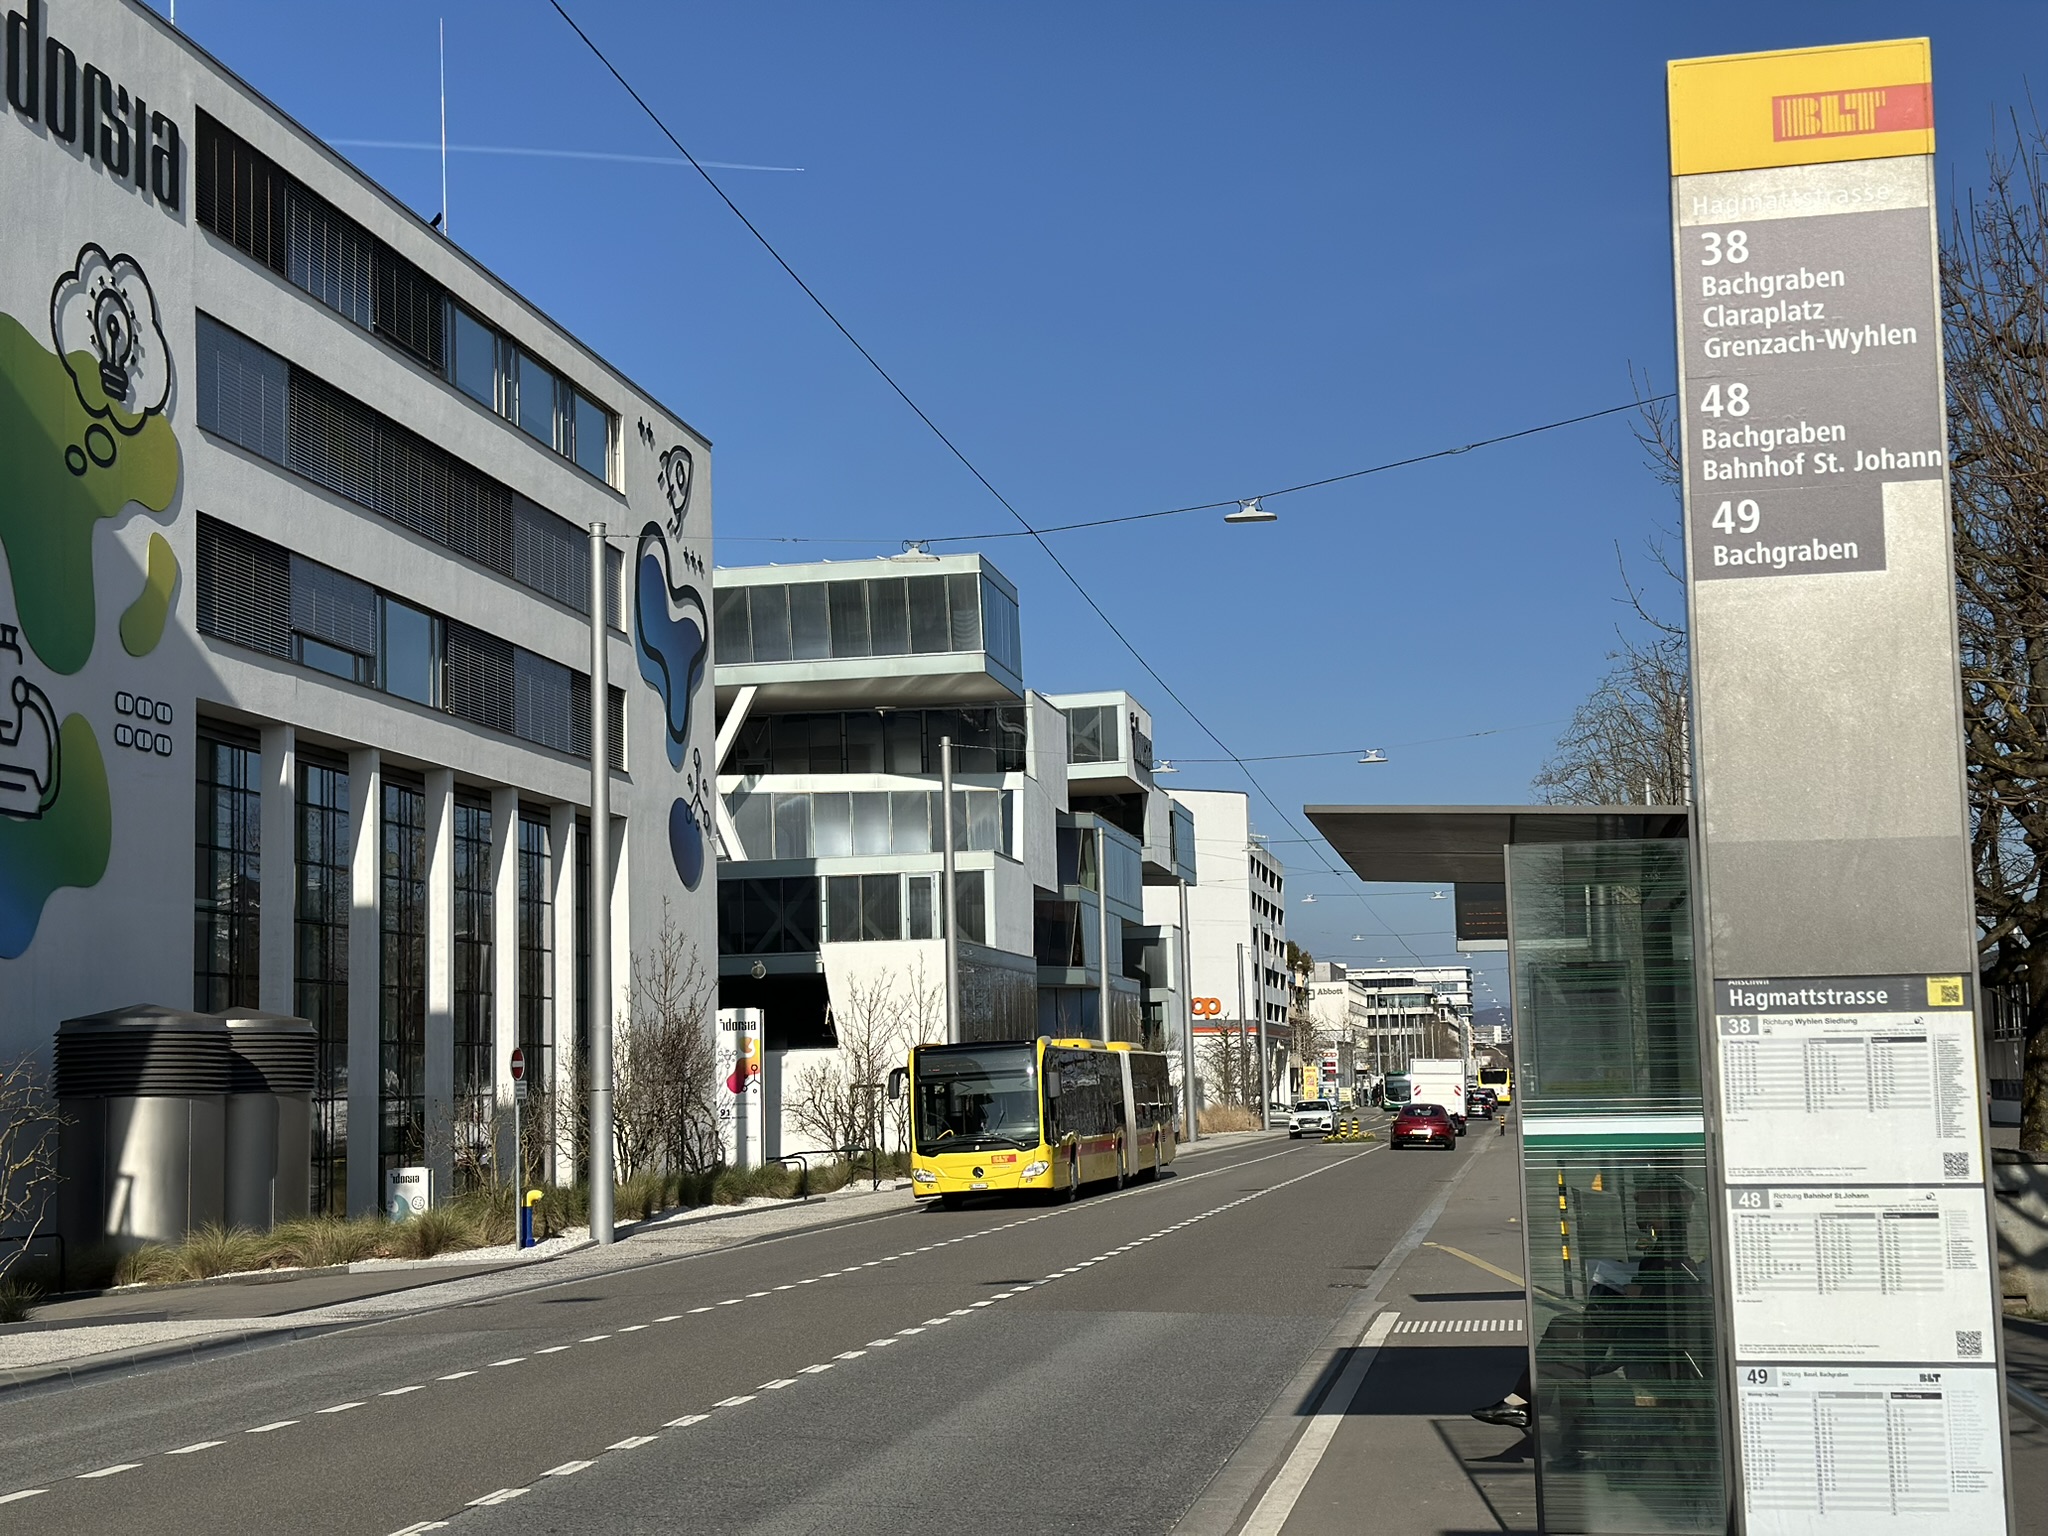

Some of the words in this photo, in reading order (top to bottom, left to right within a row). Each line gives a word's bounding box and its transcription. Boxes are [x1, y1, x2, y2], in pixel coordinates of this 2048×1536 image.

[7, 0, 180, 212] dorsia
[1780, 90, 1887, 138] BLT
[1692, 184, 1891, 218] Hagmattstrasse
[1700, 229, 1750, 266] 38
[1702, 267, 1846, 300] Bachgraben
[1703, 300, 1825, 329] Claraplatz
[1704, 324, 1918, 359] Grenzach-Wyhlen
[1700, 382, 1751, 418] 48
[1701, 421, 1847, 452] Bachgraben
[1702, 452, 1806, 482] Bahnhof
[1813, 452, 1845, 475] St.
[1853, 447, 1942, 473] Johann
[1711, 499, 1761, 535] 49
[1713, 539, 1859, 570] Bachgraben
[1316, 988, 1344, 996] Abbott
[1729, 988, 1889, 1011] Hagmattstrasse
[1191, 997, 1222, 1020] op
[1728, 1018, 1751, 1034] 38
[1762, 1018, 1794, 1026] Richtung
[1795, 1018, 1823, 1026] Wyhlen
[1825, 1017, 1858, 1026] Siedlung
[720, 1109, 731, 1117] 91
[1738, 1192, 1762, 1208] 48
[1773, 1192, 1802, 1200] Richtung
[1747, 1369, 1769, 1385] 49
[1919, 1373, 1942, 1383] BLT
